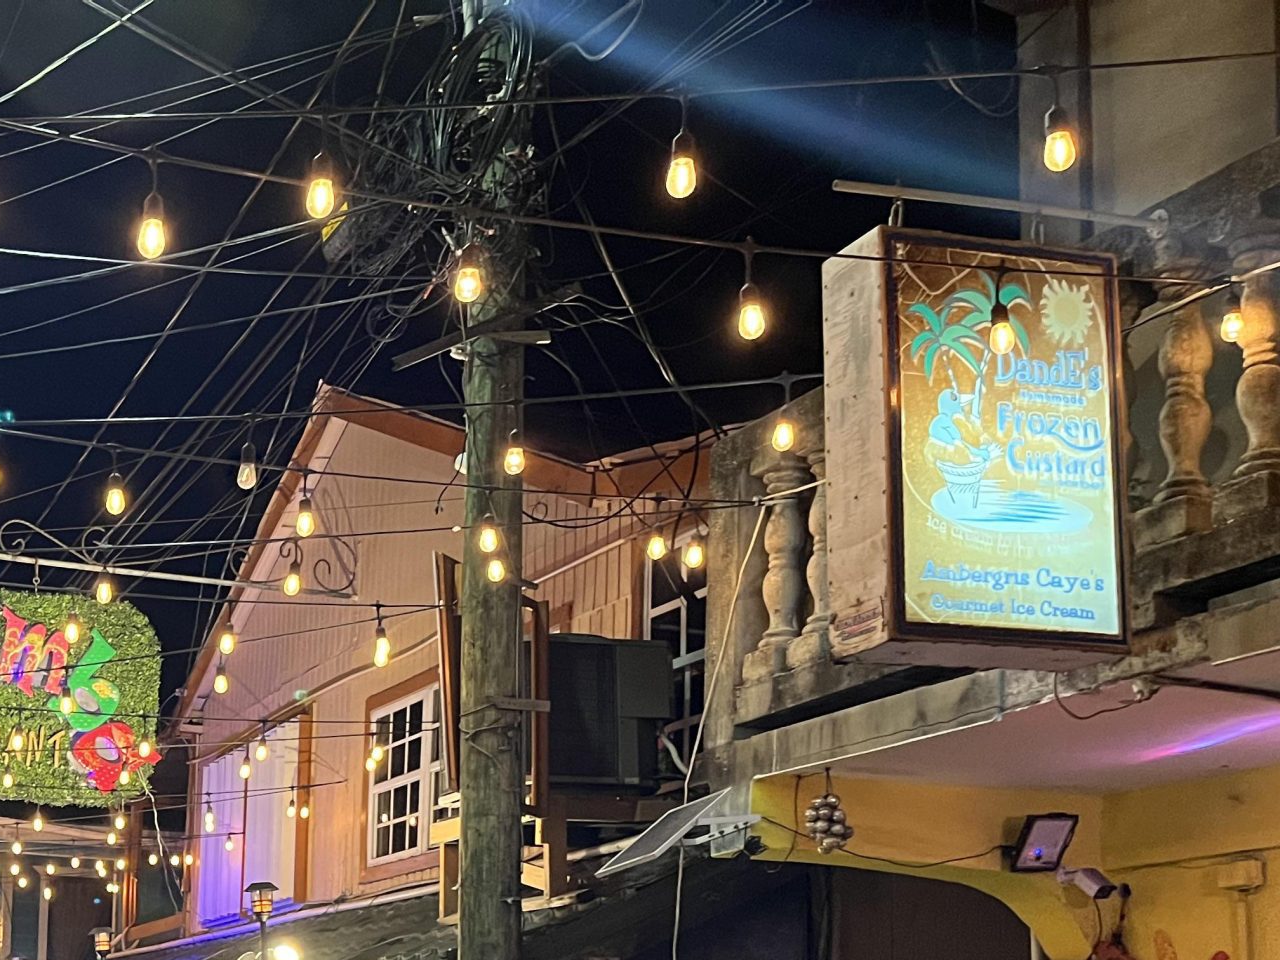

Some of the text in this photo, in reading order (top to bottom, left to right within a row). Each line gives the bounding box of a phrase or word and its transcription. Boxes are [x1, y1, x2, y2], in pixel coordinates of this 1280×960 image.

[997, 402, 1104, 451] Frozen
[1007, 438, 1106, 477] Custard
[923, 560, 1105, 593] Ambergris Caye's
[931, 593, 1096, 620] Gourmet Ice Cream
